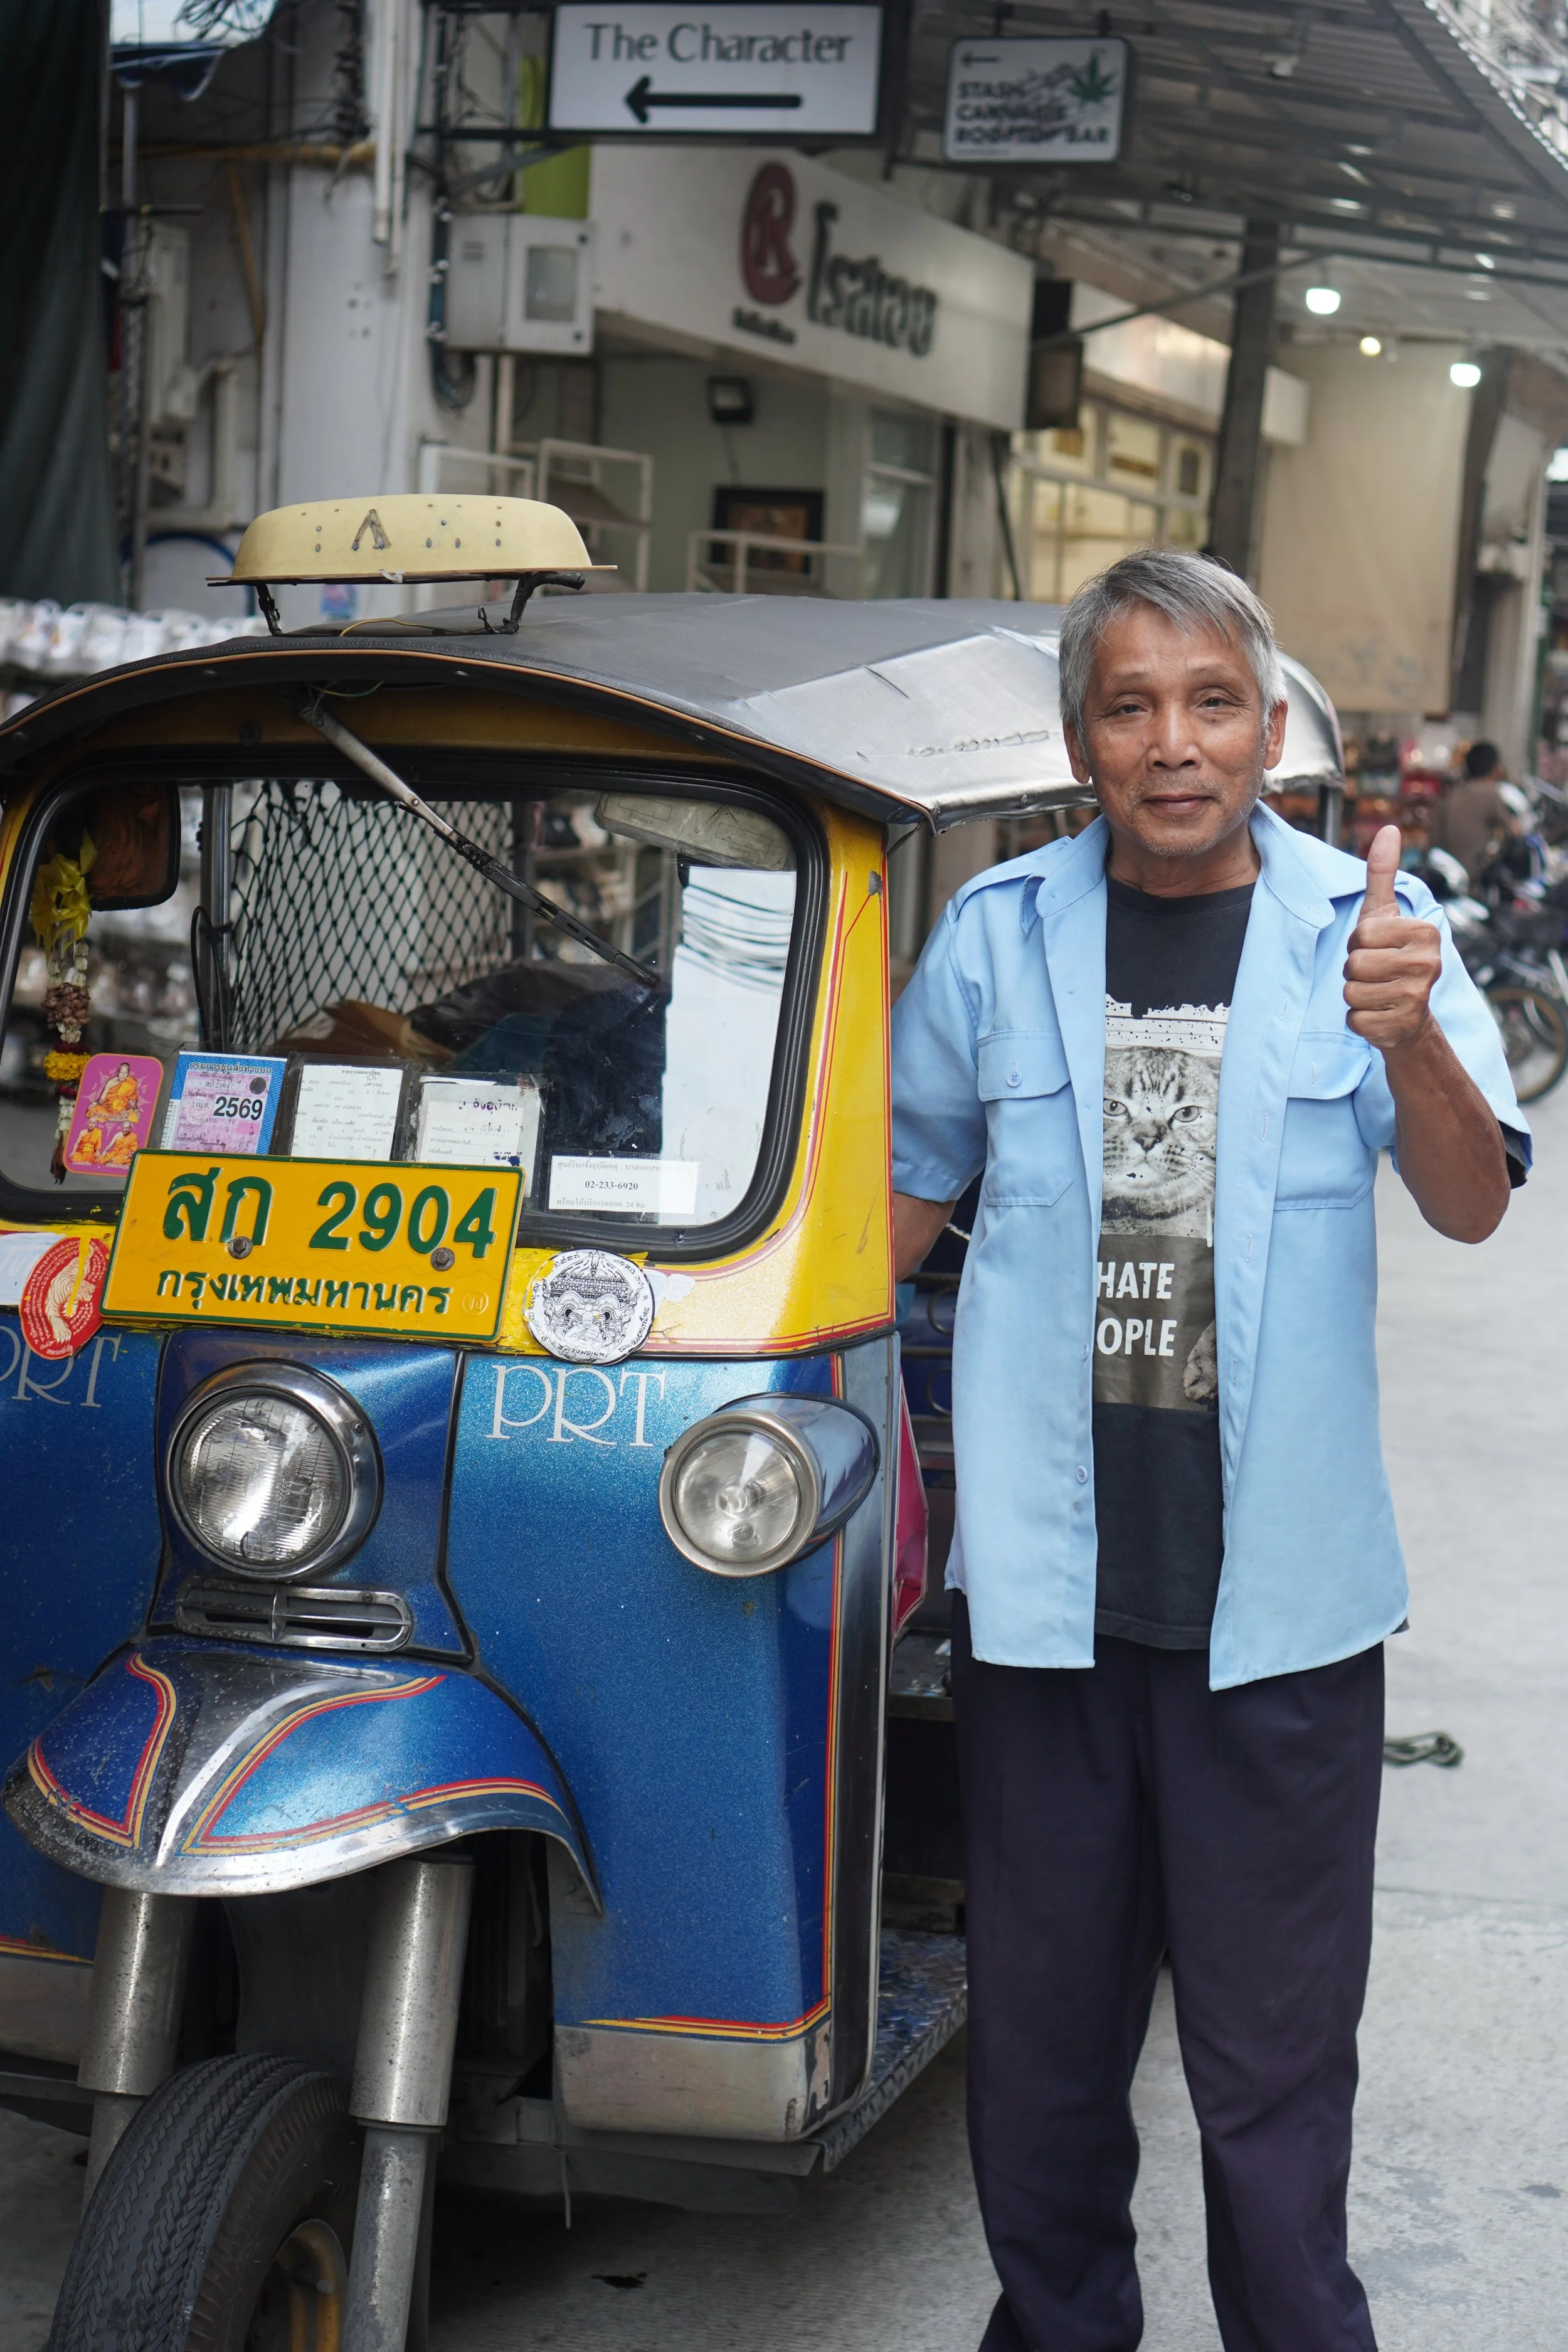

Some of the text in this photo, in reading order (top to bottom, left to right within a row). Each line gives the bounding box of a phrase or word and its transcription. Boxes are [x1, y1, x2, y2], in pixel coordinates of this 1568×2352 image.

[583, 23, 853, 63] The Character
[188, 1061, 272, 1074] กรมการขนส่งทางบก
[213, 1096, 263, 1121] 2569
[556, 1196, 623, 1208] พร้อมให้บริการตลอด
[585, 1180, 638, 1190] 02-233-6920
[163, 1167, 497, 1259] สก 2904
[157, 1270, 453, 1315] กรุงเทพมหานคร
[1097, 1261, 1175, 1300] HATE
[485, 1364, 666, 1447] PRT
